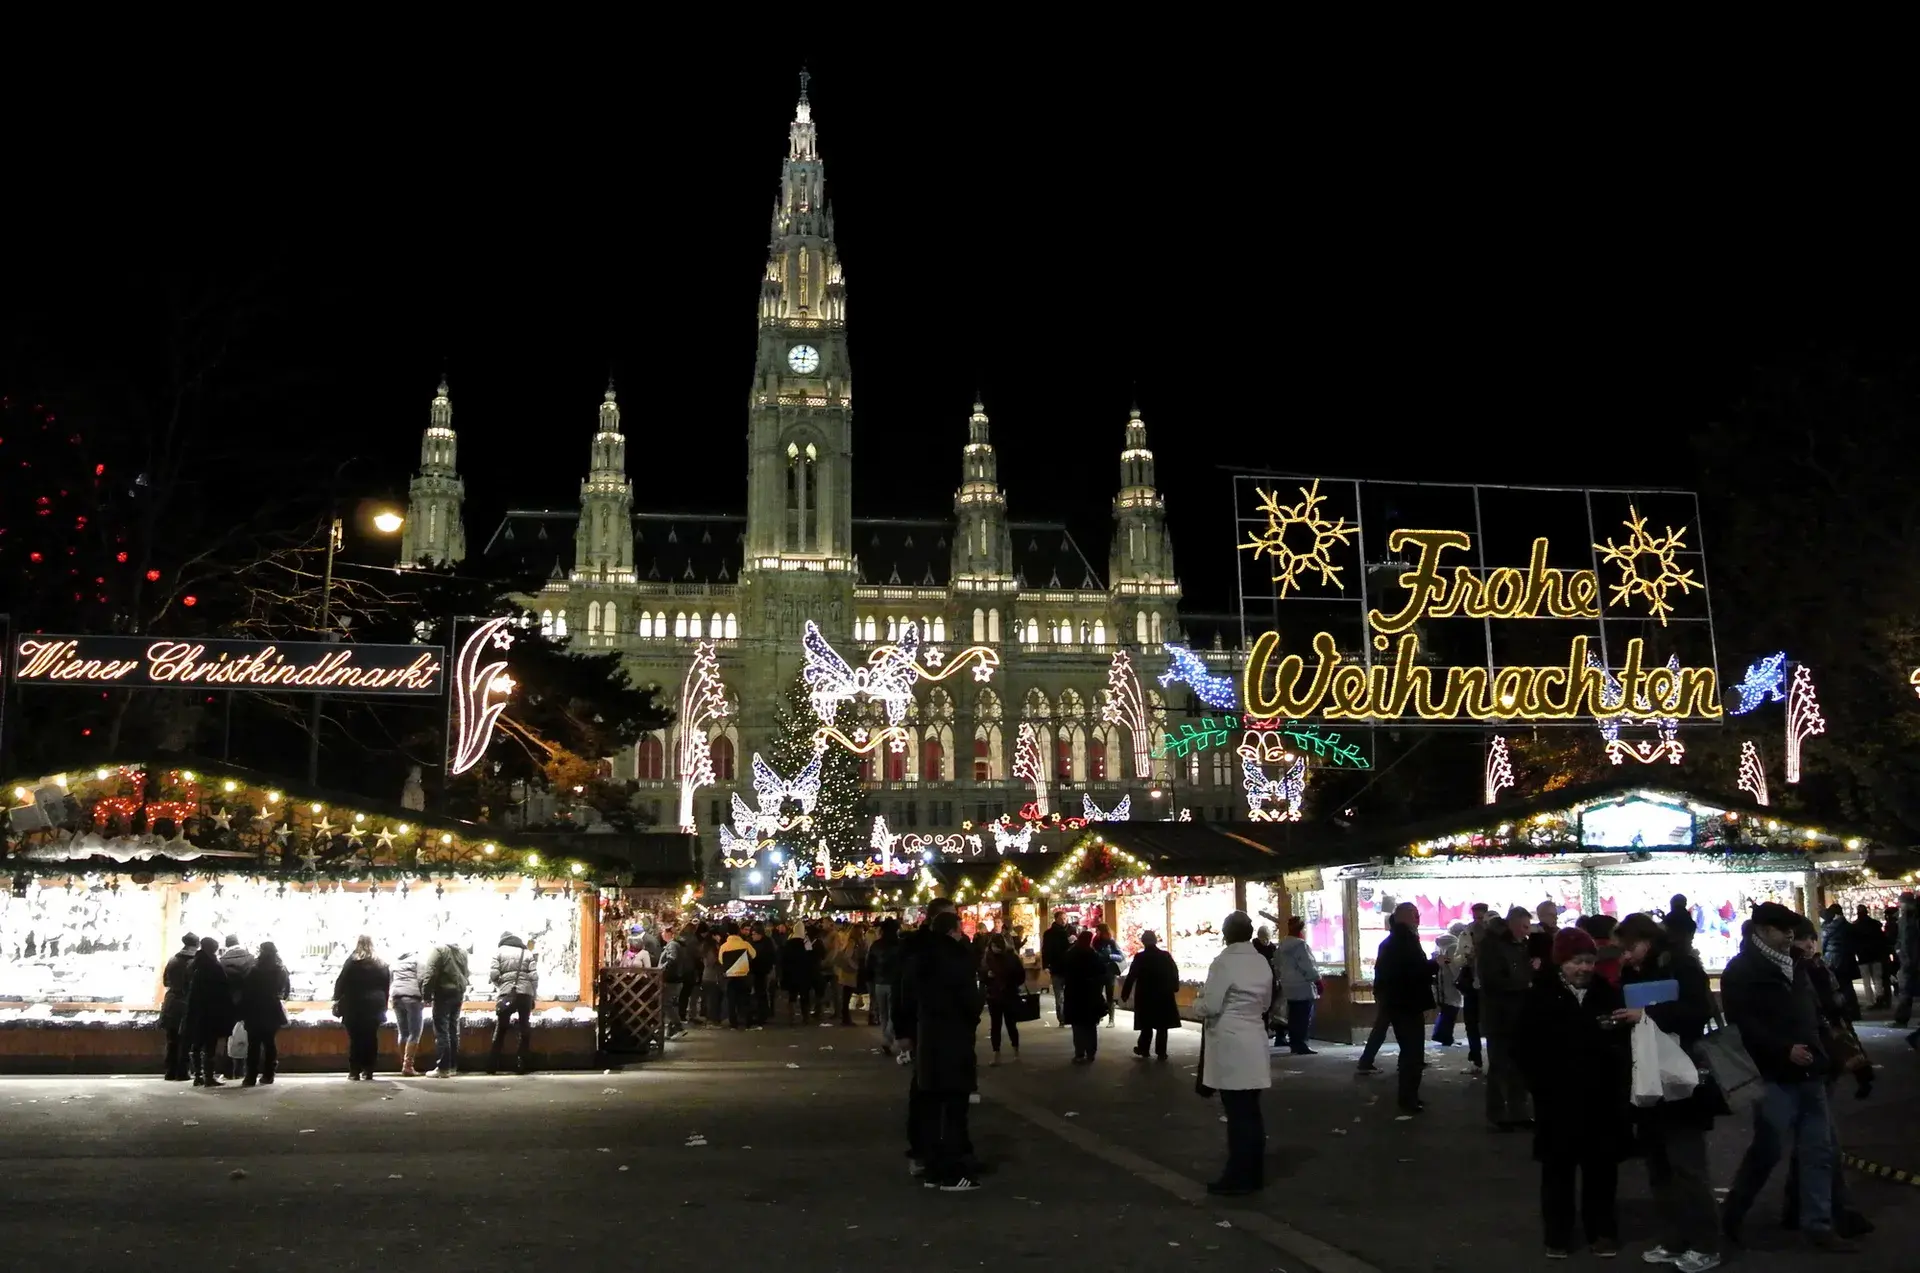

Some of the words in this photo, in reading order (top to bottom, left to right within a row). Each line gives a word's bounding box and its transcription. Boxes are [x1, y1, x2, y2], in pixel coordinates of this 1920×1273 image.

[1369, 529, 1600, 633] Frohe
[19, 640, 138, 680] Wiener
[146, 641, 441, 689] Christkindlmarkt
[1243, 631, 1722, 719] Weihnachten
